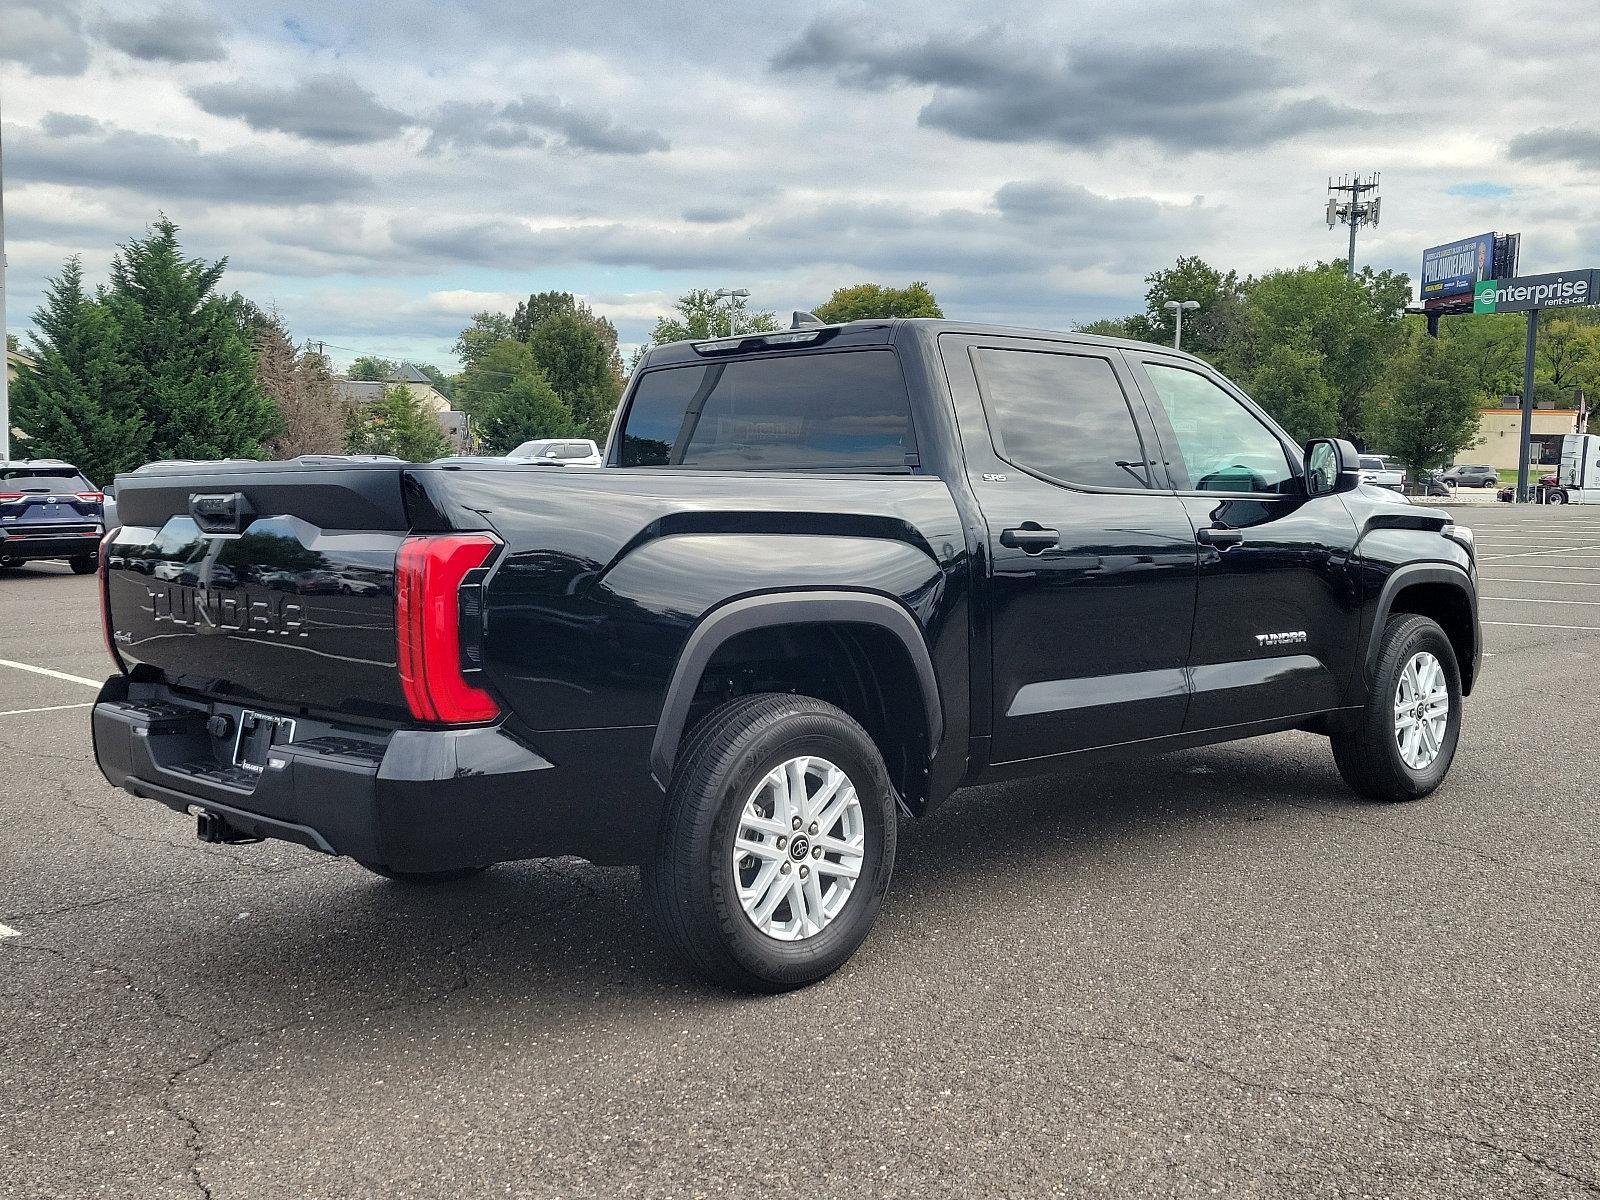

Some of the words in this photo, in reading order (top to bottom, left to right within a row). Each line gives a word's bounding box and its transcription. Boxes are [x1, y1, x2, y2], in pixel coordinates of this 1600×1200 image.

[1480, 278, 1588, 305] enterprise
[1544, 295, 1587, 306] rent-a-car
[983, 473, 1007, 482] SR5
[146, 586, 309, 637] TUNDRA
[1254, 630, 1307, 647] TUNDRA
